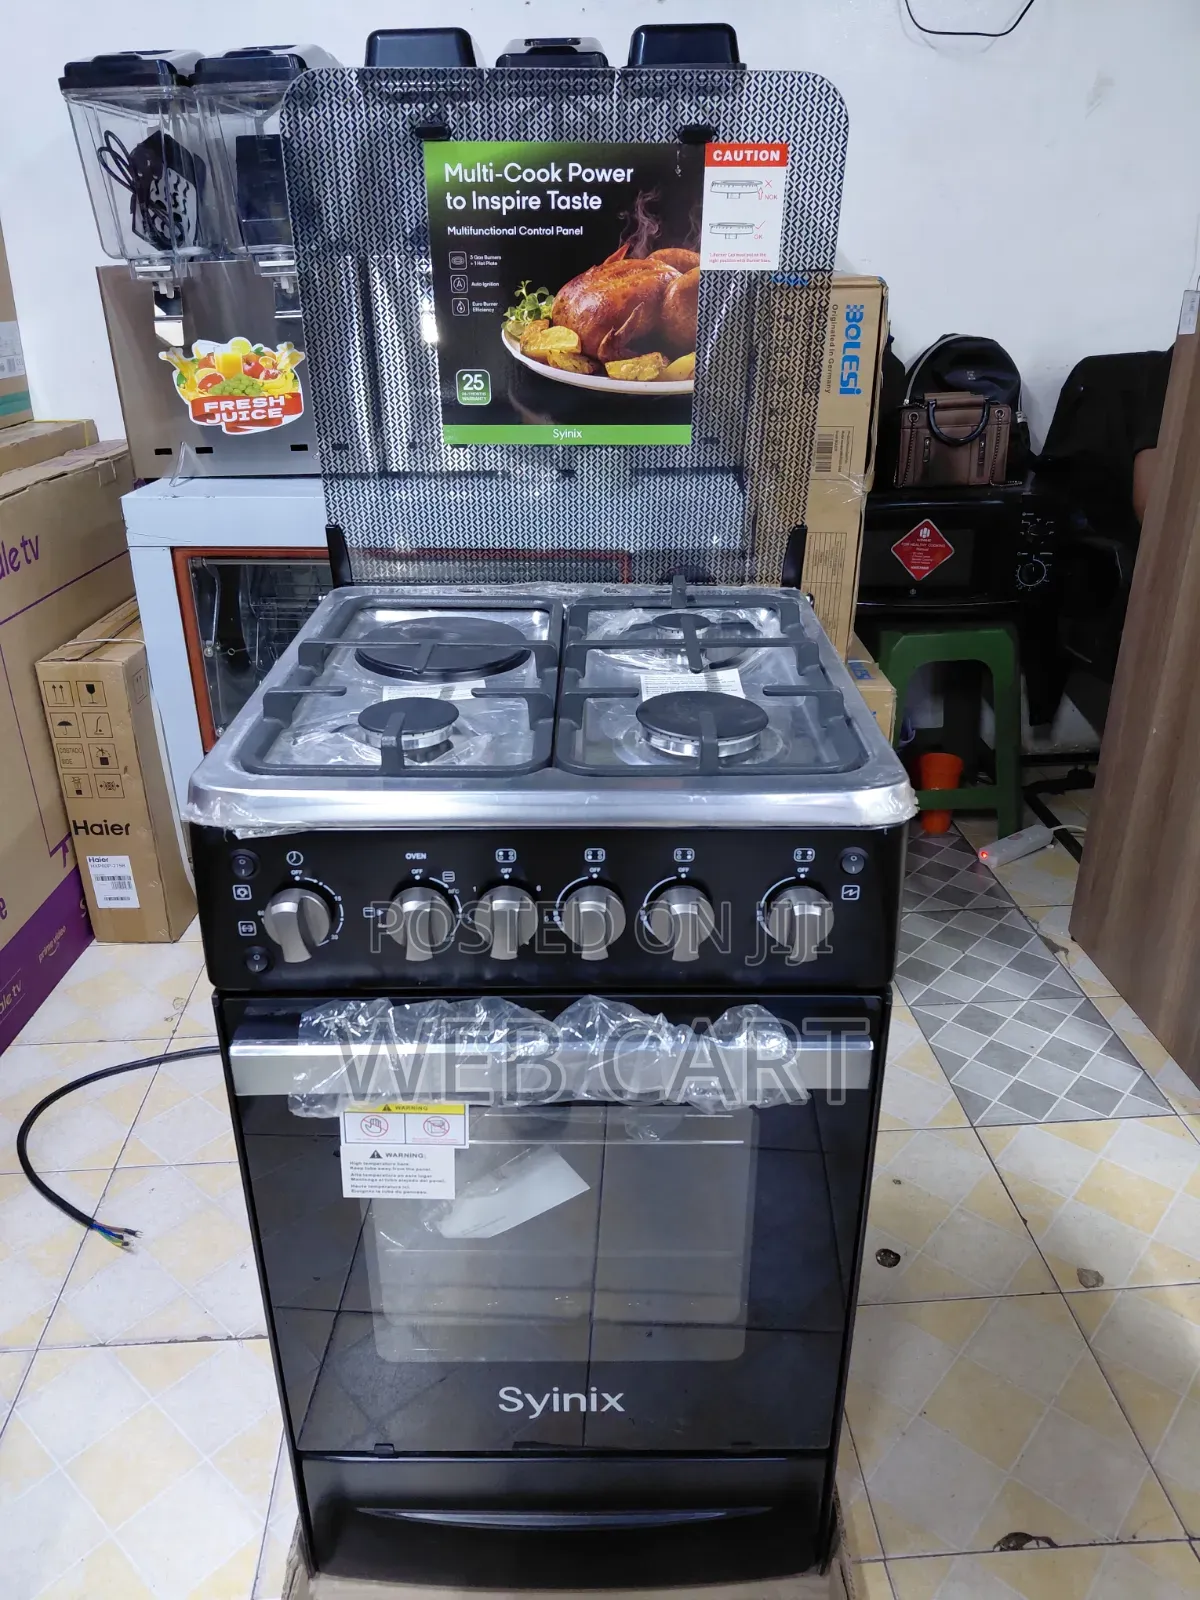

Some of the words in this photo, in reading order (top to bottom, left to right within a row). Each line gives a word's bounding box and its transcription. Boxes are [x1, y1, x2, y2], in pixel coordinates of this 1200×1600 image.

[712, 149, 781, 162] CAUTION
[444, 161, 563, 183] Multi-Cook
[568, 162, 634, 183] Power
[445, 191, 467, 210] to
[471, 189, 542, 216] Inspire
[546, 190, 603, 210] Taste
[447, 225, 517, 237] Multifunctional
[518, 225, 555, 237] Control
[556, 225, 584, 237] Panel
[482, 281, 500, 289] Ignition
[829, 304, 839, 347] Originated
[461, 373, 485, 391] 25
[825, 358, 836, 394] Germany
[203, 395, 286, 413] FRESH
[205, 407, 284, 424] JUICE
[552, 428, 583, 439] Syinix
[72, 819, 131, 836] Haier
[405, 852, 427, 860] OVEN
[498, 1386, 626, 1419] Syinix
